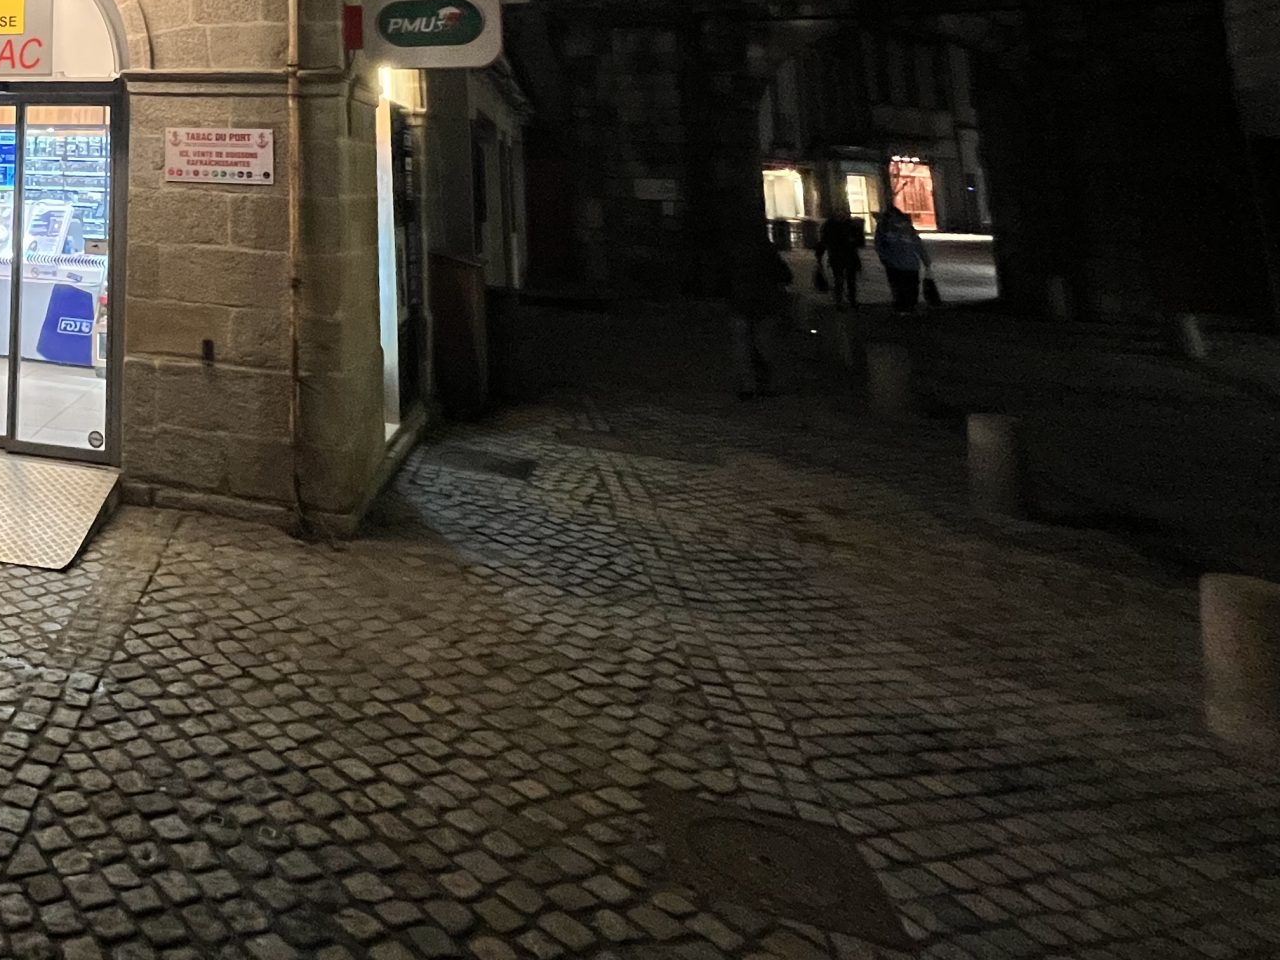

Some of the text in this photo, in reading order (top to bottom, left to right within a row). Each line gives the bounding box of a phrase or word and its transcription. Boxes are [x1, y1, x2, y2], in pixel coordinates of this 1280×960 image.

[387, 16, 435, 34] PMU
[185, 132, 251, 143] TABAC DU PORT
[61, 320, 80, 331] FDJ
